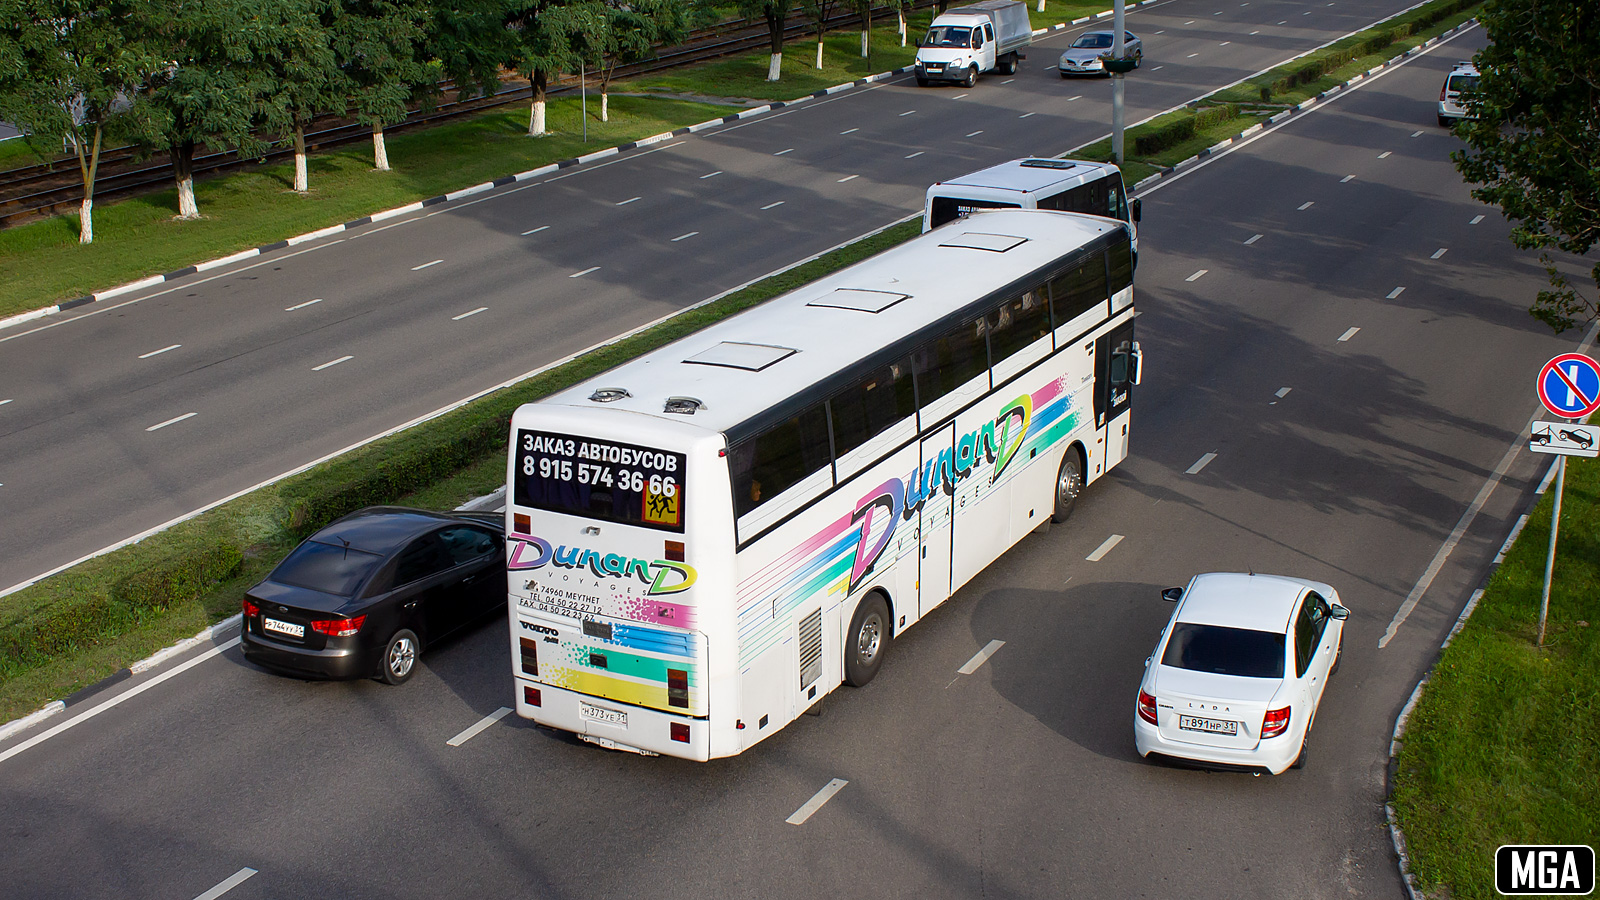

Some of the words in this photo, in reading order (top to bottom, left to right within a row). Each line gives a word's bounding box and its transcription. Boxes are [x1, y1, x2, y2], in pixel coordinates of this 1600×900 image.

[523, 434, 576, 457] ЗАКАЗ
[578, 442, 677, 472] АВТОБУСОВ
[523, 455, 535, 476] 8
[539, 457, 573, 482] 915
[578, 463, 613, 488] 574
[617, 469, 644, 493] 36
[649, 474, 676, 498] 66
[897, 476, 993, 551] VOYAGES
[548, 571, 647, 596] VOYAGES
[540, 585, 563, 598] 74960
[565, 591, 600, 605] MEYTHET
[545, 595, 555, 604] 04
[556, 598, 567, 607] 50
[568, 600, 578, 610] 22
[580, 603, 590, 612] 27
[593, 606, 602, 615] 12
[538, 603, 548, 611] 04
[550, 606, 560, 614] 50
[561, 608, 571, 617] 22
[573, 611, 582, 620] 23
[584, 613, 595, 622] 67
[519, 620, 559, 637] VOLVO
[1188, 702, 1230, 712] LADA
[1223, 721, 1234, 730] 31
